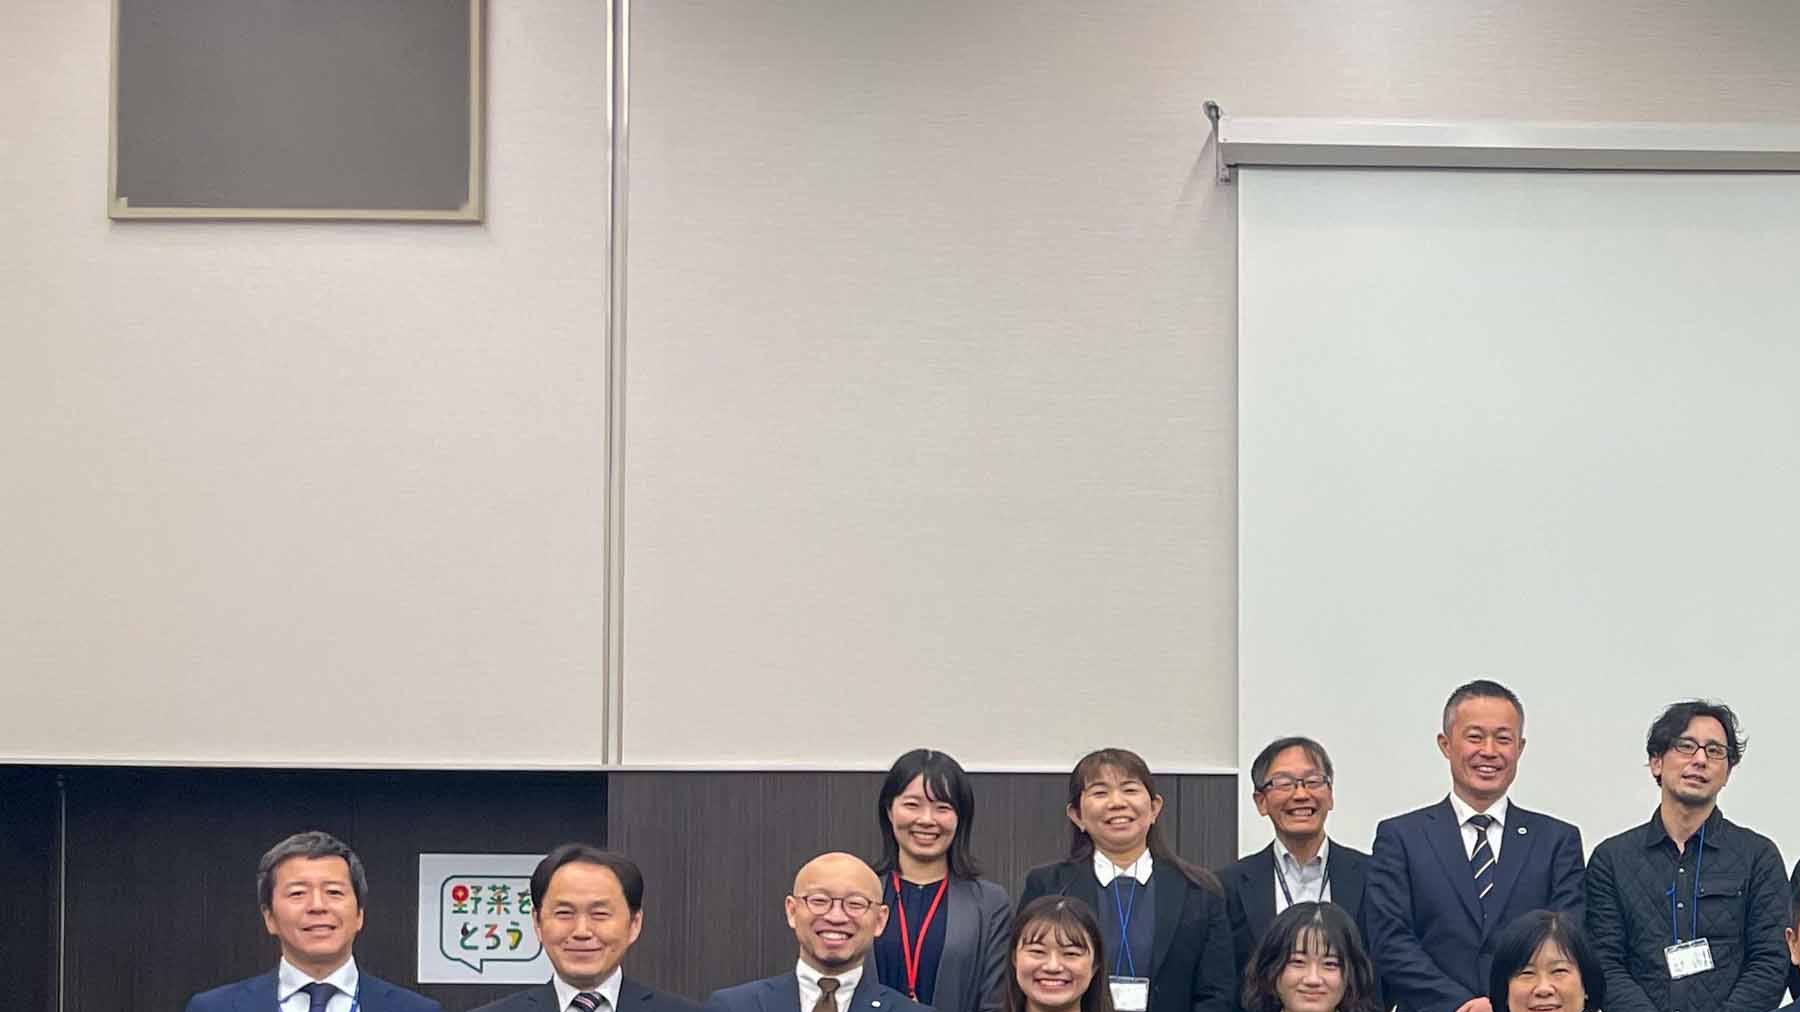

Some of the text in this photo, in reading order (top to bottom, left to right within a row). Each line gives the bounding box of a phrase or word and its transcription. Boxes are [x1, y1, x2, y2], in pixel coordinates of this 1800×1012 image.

[452, 884, 532, 915] 野菜を
[459, 921, 523, 950] とろう
